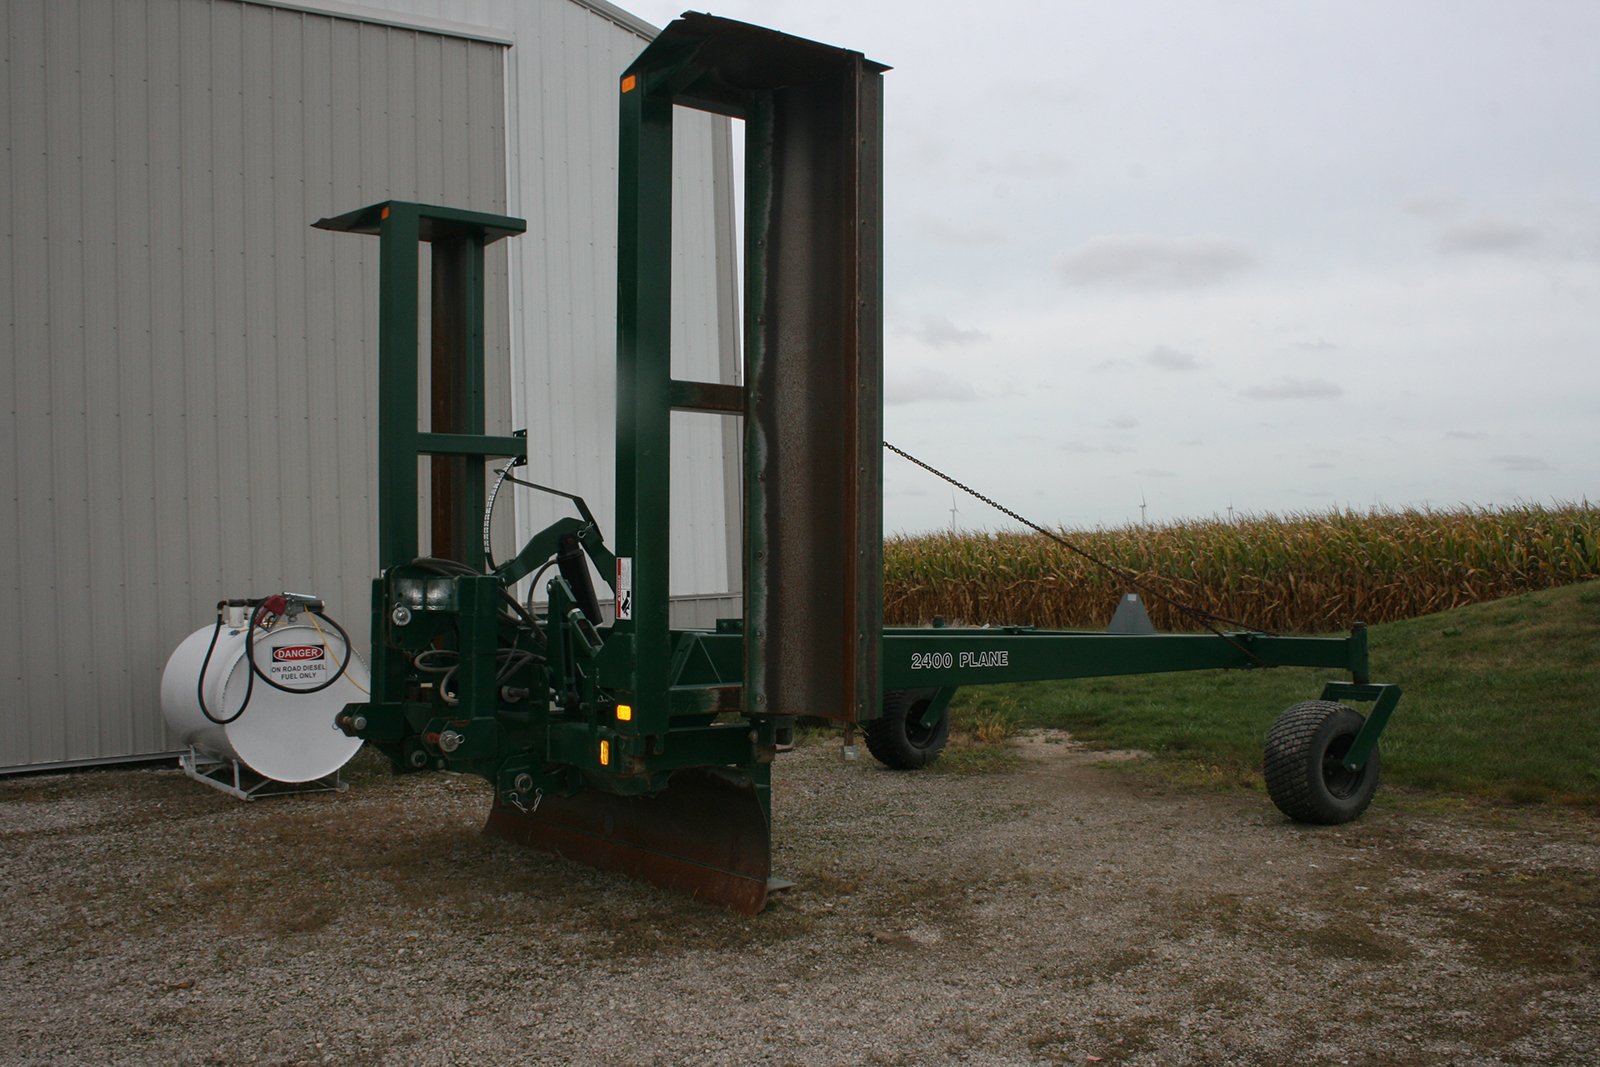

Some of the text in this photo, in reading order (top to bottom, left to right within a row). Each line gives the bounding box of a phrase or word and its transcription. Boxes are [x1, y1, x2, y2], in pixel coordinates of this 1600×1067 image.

[278, 649, 318, 658] DANGER
[911, 651, 1009, 669] 2400 PLANE
